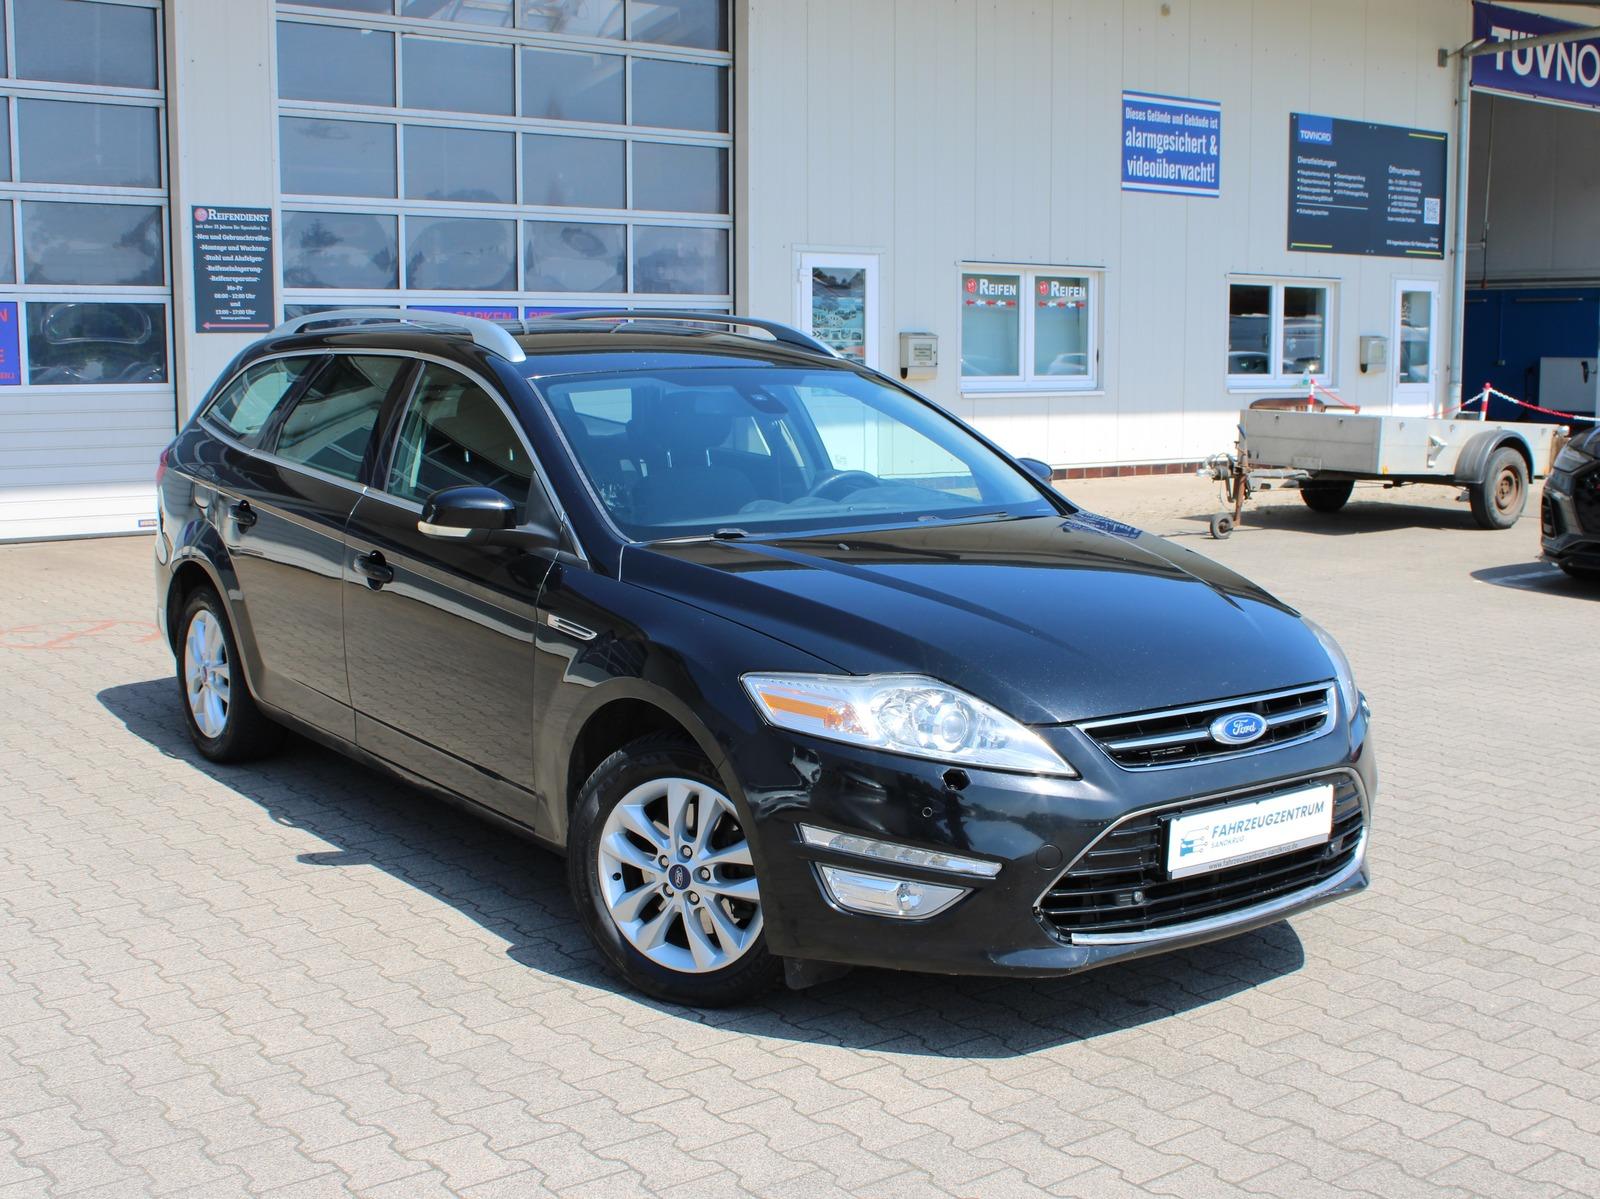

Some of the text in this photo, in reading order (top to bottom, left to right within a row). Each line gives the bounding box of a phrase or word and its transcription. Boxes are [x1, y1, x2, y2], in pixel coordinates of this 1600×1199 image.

[1125, 107, 1146, 121] Dieses
[1172, 114, 1183, 125] und
[1184, 114, 1209, 129] Gebäude
[1209, 117, 1218, 129] ist
[1125, 126, 1218, 156] alarmgesichert &
[1127, 155, 1215, 183] videoüberwacht!
[1232, 718, 1257, 736] Ford
[1211, 801, 1325, 839] FAHRZEUGZENTRUM
